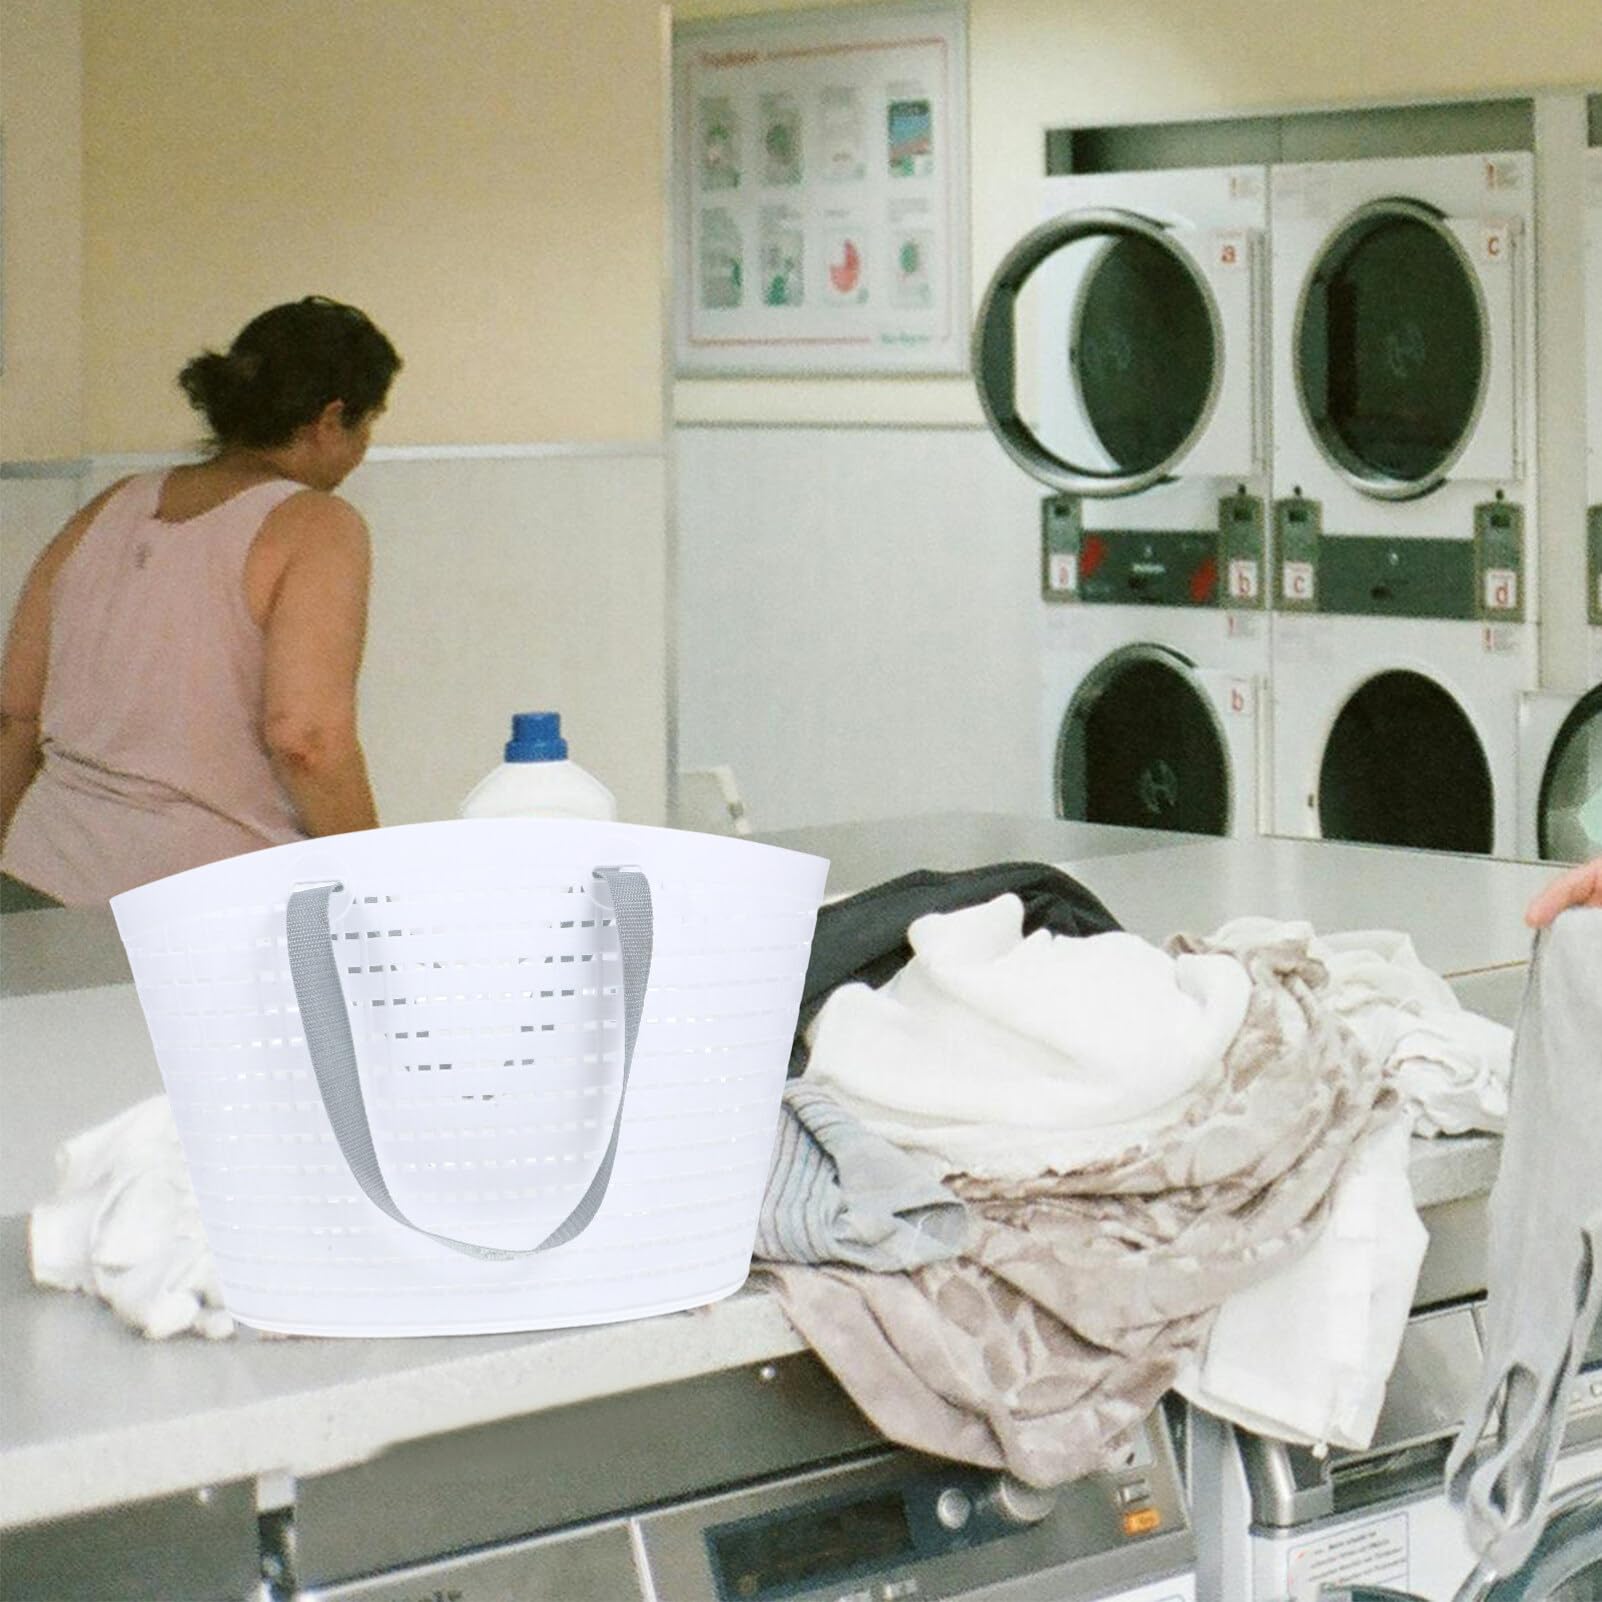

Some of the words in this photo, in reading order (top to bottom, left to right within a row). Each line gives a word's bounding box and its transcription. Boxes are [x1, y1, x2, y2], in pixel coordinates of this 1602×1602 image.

[1221, 244, 1237, 264] a
[1487, 236, 1502, 256] c
[1237, 571, 1252, 597] b
[1293, 575, 1305, 596] c
[1495, 581, 1509, 608] d
[1231, 687, 1245, 712] b
